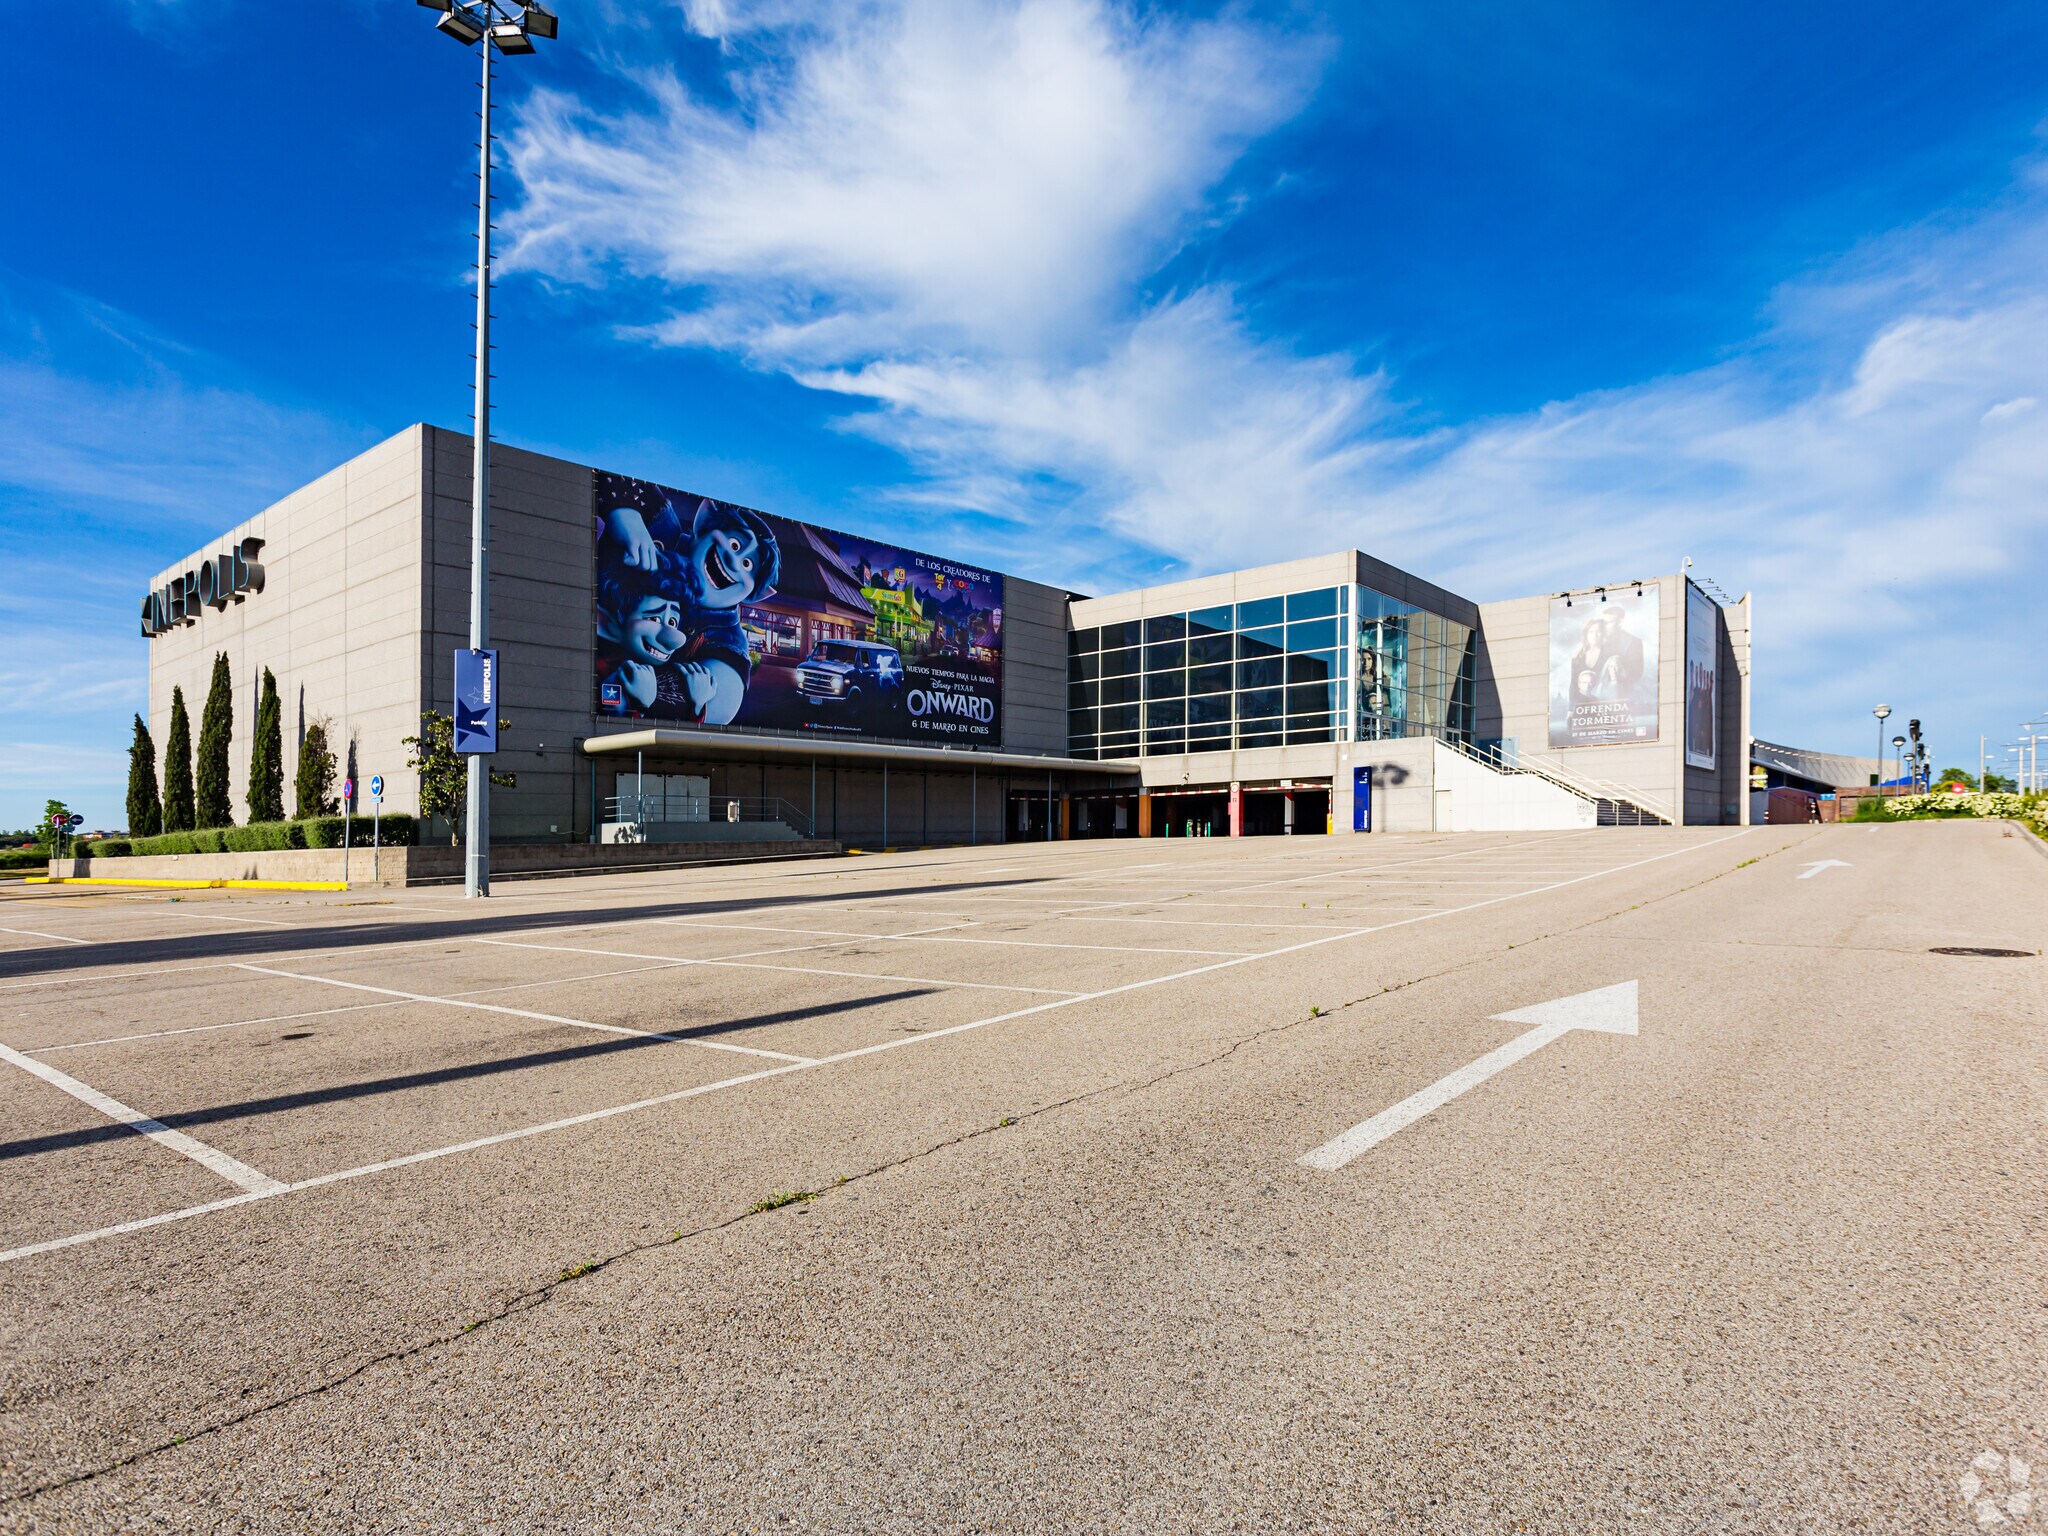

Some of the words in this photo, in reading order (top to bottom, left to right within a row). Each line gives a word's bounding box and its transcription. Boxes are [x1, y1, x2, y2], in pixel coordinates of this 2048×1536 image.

[915, 558, 925, 567] DE
[927, 561, 941, 571] LOS
[943, 565, 981, 582] CREADORES
[982, 574, 991, 583] DE
[141, 536, 265, 637] KINEPOLIS
[936, 583, 943, 591] 4
[953, 579, 975, 590] COCO
[483, 658, 491, 704] KINEPOLIS
[906, 665, 930, 675] NUEVOS
[931, 668, 955, 678] TIEMPOS
[956, 672, 969, 682] PARA
[979, 676, 995, 684] MAGIA
[930, 678, 951, 692] Disney
[953, 683, 974, 692] PIXAR
[906, 689, 995, 723] ONWARD
[1575, 703, 1629, 715] OFRENDA
[911, 719, 918, 728] 6
[920, 720, 930, 729] DE
[932, 722, 957, 733] MARZO
[958, 724, 968, 732] EN
[970, 725, 989, 734] CINES
[1571, 714, 1633, 726] TORMENTA
